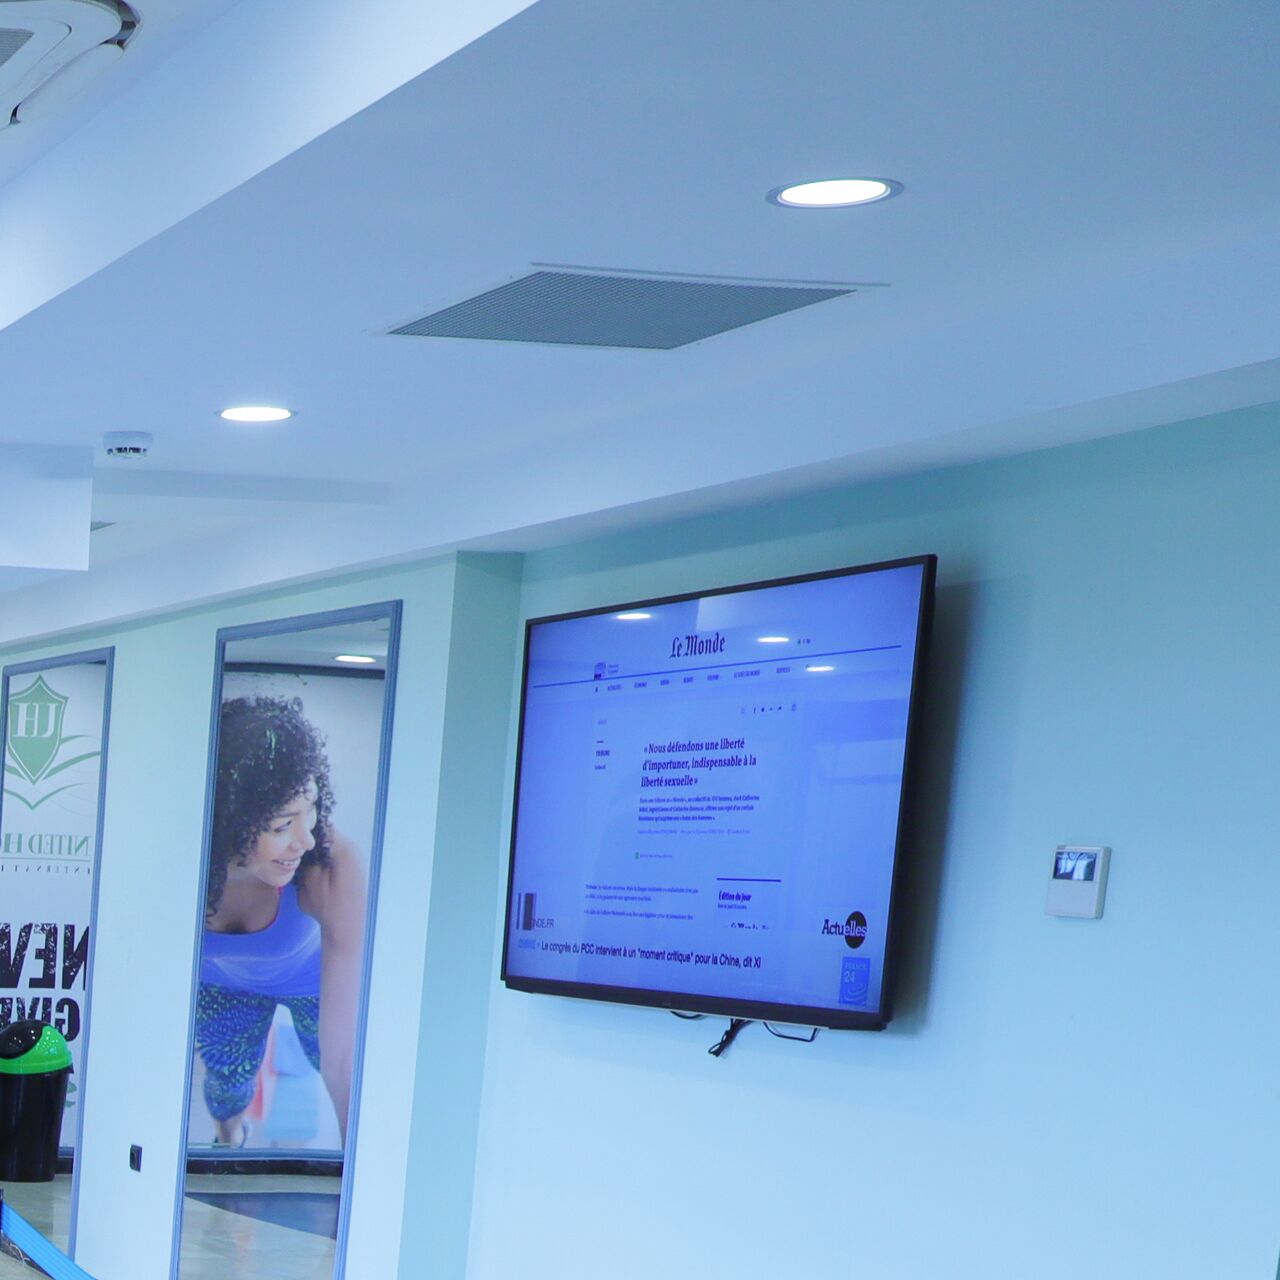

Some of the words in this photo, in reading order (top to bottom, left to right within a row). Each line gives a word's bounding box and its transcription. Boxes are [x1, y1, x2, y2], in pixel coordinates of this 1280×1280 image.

[669, 637, 682, 658] Le
[683, 632, 725, 656] Monde
[648, 743, 666, 754] Nous
[667, 740, 704, 753] défendons
[705, 741, 719, 751] une
[720, 737, 745, 750] liberté
[691, 755, 742, 771] indispensable
[749, 754, 757, 766] la
[641, 776, 663, 788] liberté
[665, 774, 693, 787] sexuelle
[822, 919, 867, 937] Actuelles
[572, 942, 580, 953] du
[581, 943, 595, 954] PCC
[595, 944, 621, 957] intervient
[628, 948, 637, 958] un
[695, 954, 711, 965] pour
[719, 953, 741, 968] Chine,
[743, 955, 752, 968] dit
